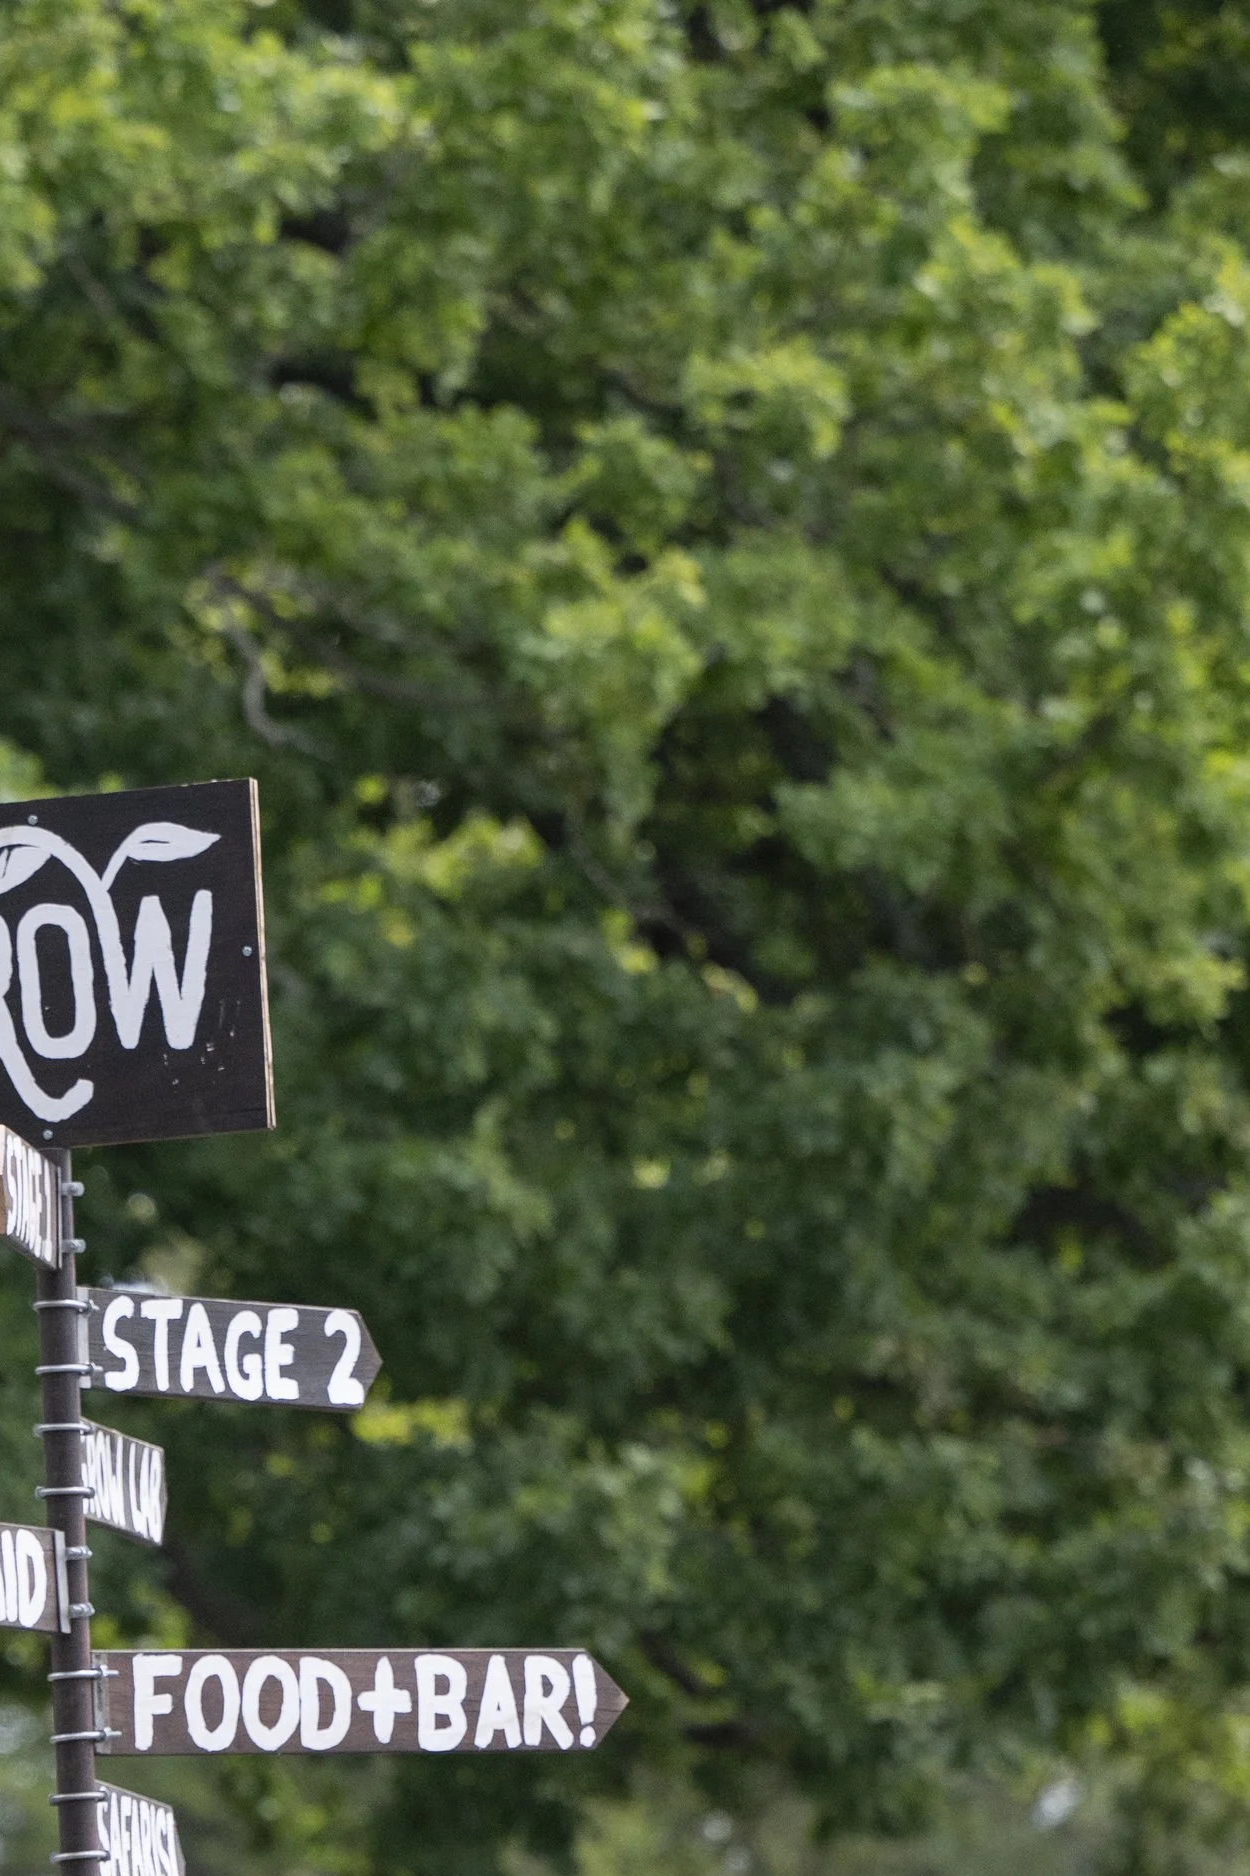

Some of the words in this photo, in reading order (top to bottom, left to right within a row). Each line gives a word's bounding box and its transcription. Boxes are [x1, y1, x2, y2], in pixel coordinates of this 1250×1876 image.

[6, 1133, 43, 1258] STAGE
[102, 1294, 300, 1402] STAGE
[324, 1308, 365, 1406] 2
[128, 1441, 162, 1543] LAB
